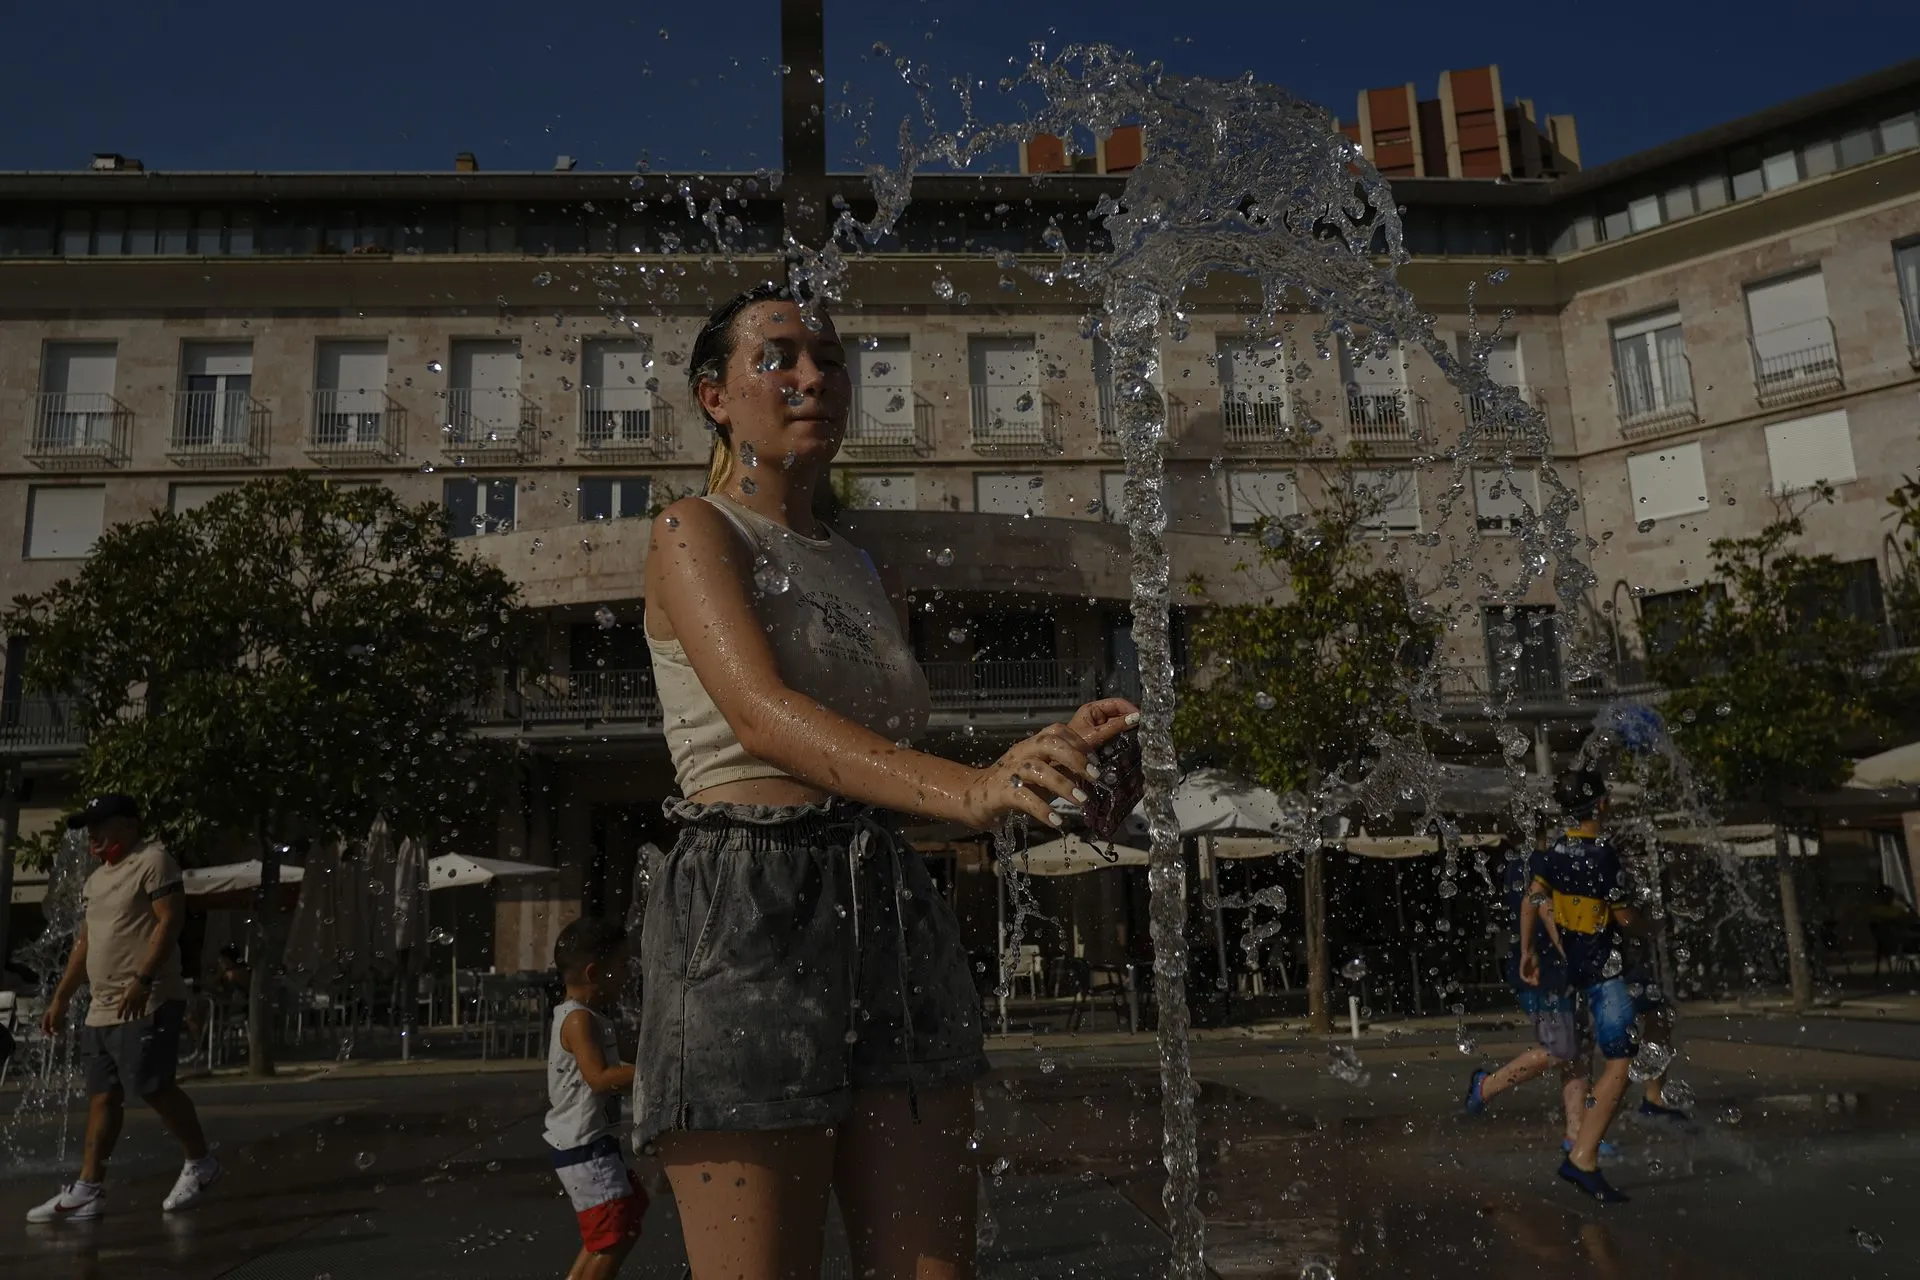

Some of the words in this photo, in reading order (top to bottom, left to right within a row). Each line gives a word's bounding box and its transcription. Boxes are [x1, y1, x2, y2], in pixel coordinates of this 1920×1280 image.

[812, 647, 839, 659] ENJOY
[841, 653, 860, 663] THE
[862, 658, 898, 671] BREEZE
